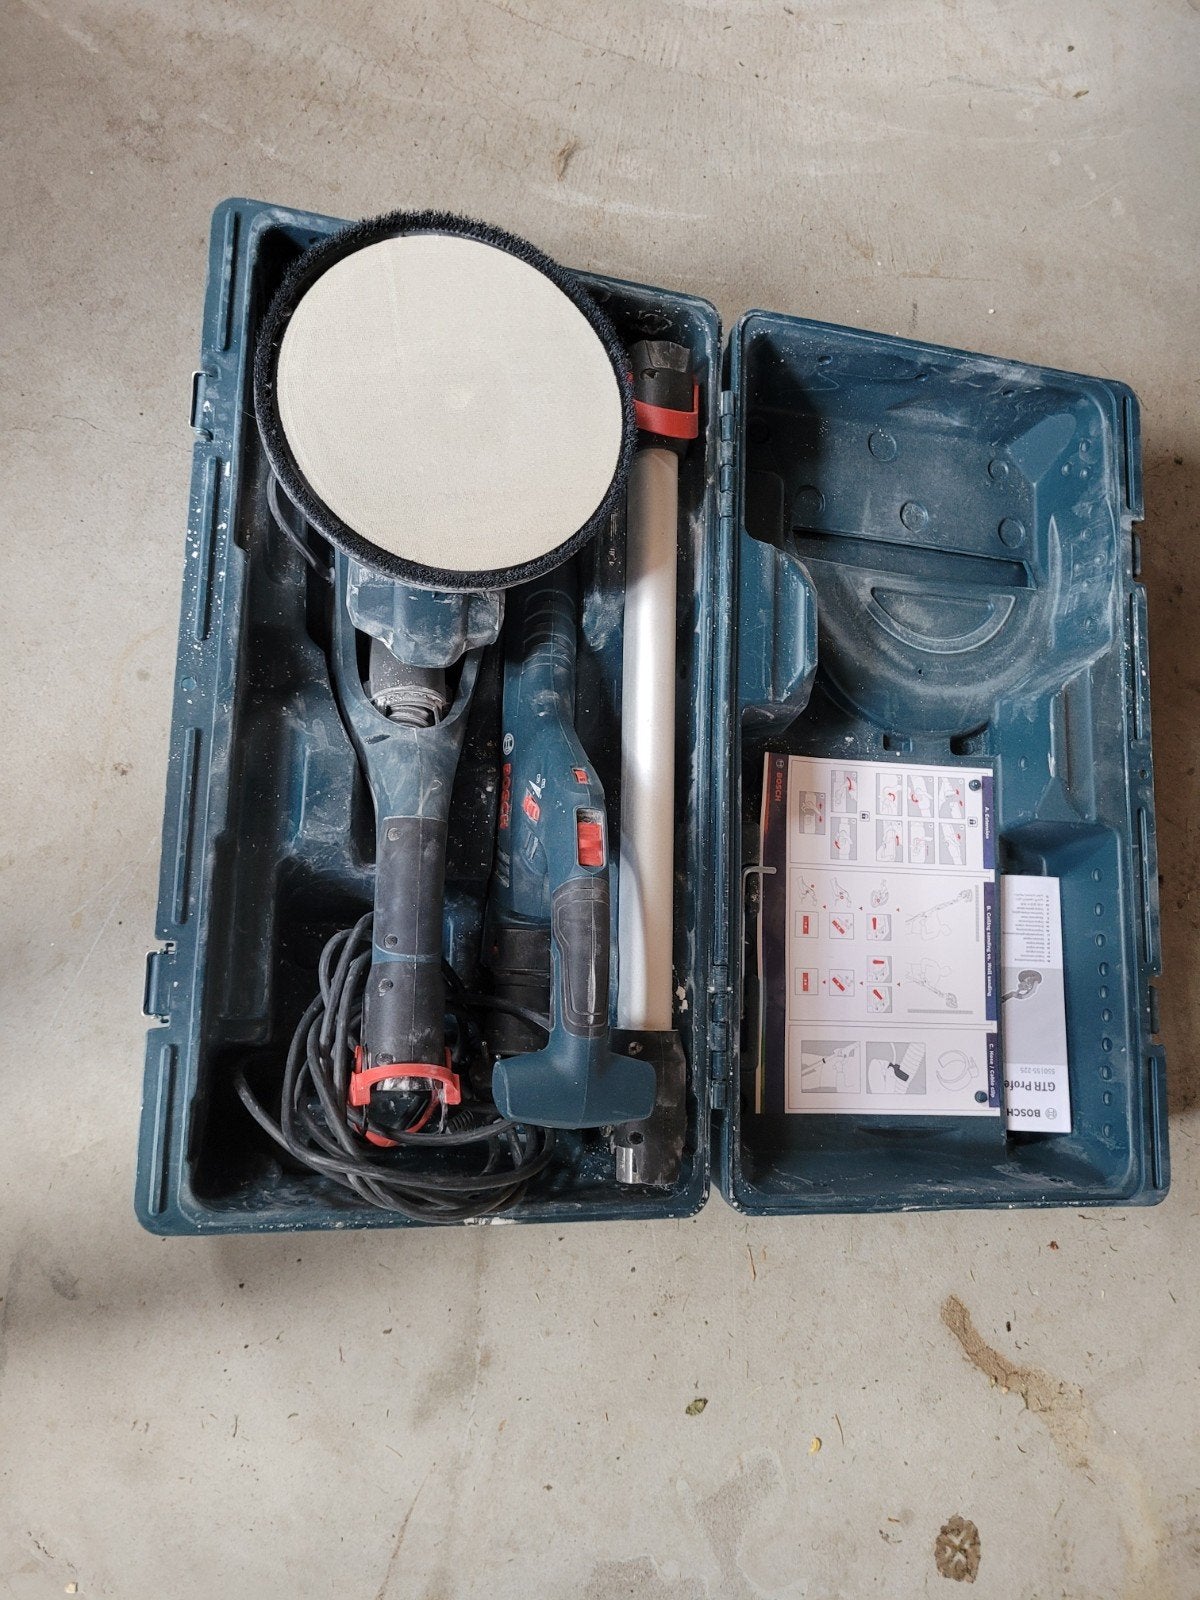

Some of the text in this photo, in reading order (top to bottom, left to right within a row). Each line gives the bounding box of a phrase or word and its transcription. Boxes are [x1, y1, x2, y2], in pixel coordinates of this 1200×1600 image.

[1004, 1080, 1055, 1092] GTR Profe
[1006, 1108, 1040, 1117] BOSCH
